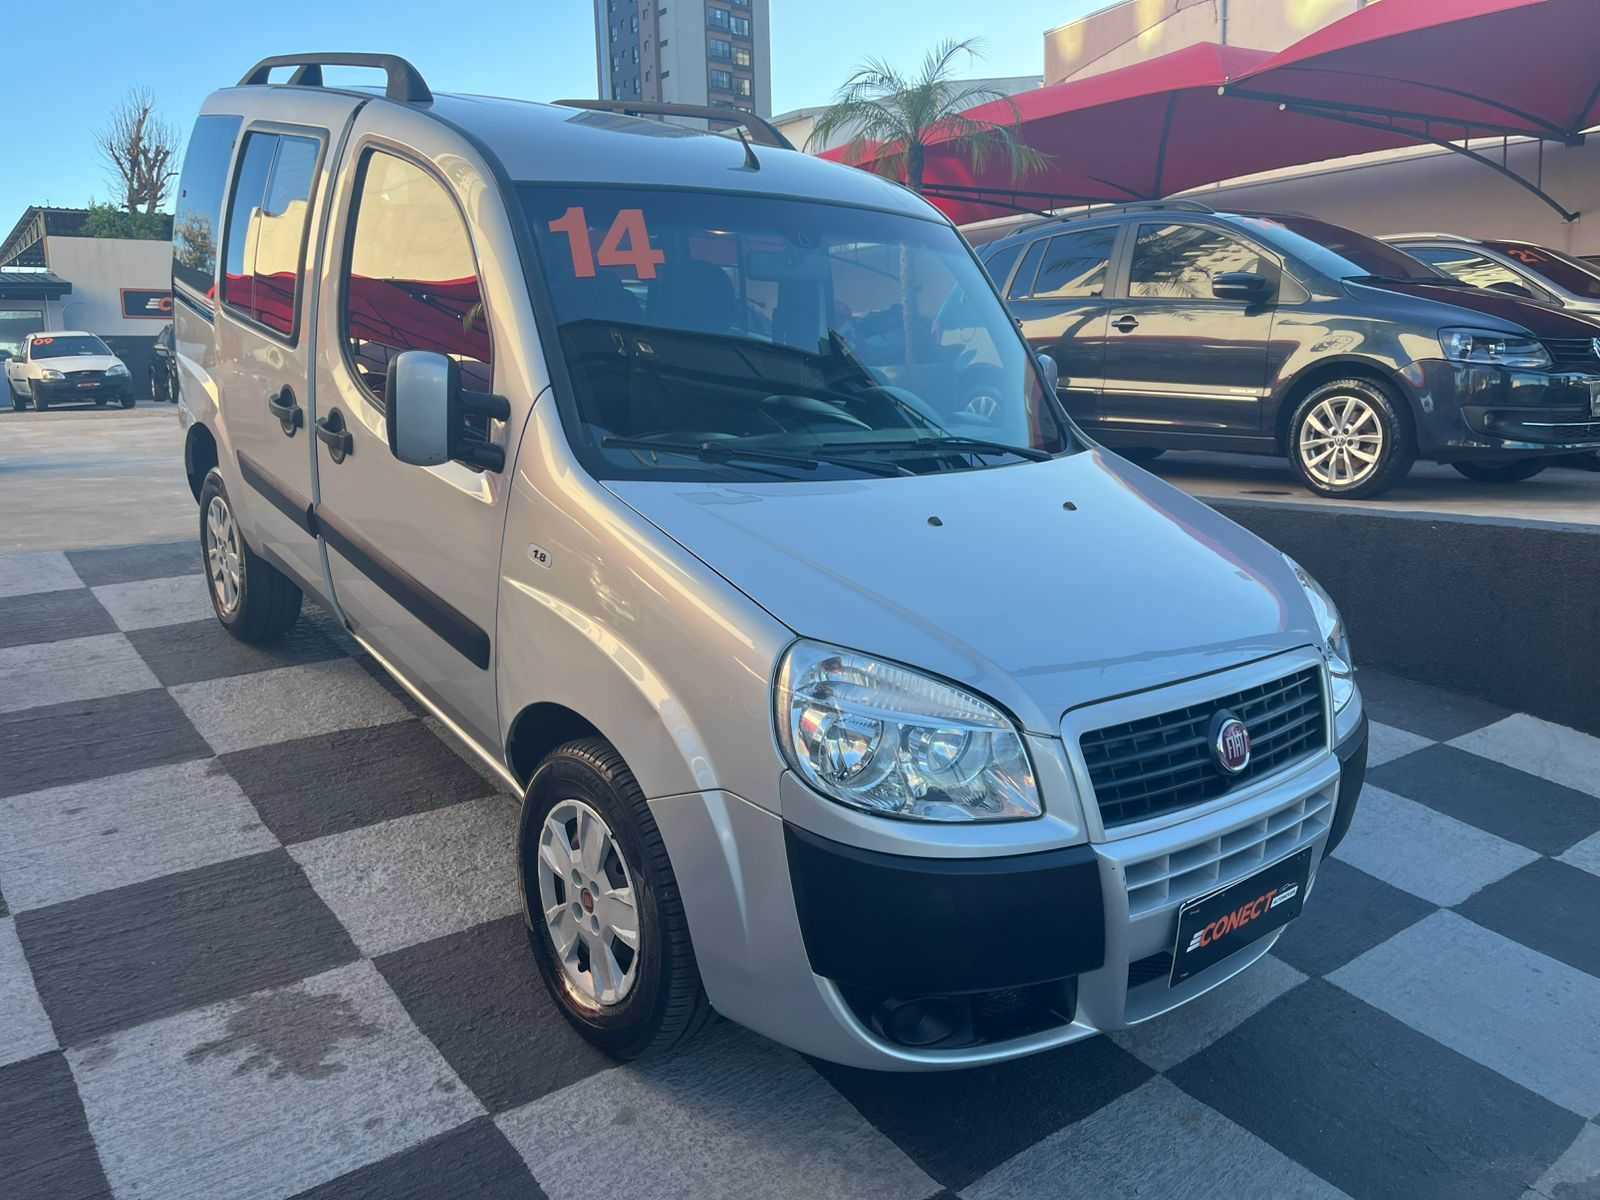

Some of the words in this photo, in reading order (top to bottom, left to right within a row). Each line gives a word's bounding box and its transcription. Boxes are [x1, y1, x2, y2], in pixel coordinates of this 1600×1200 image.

[548, 206, 665, 279] 14
[1225, 732, 1245, 760] FIAT
[1200, 888, 1278, 947] CONECT
